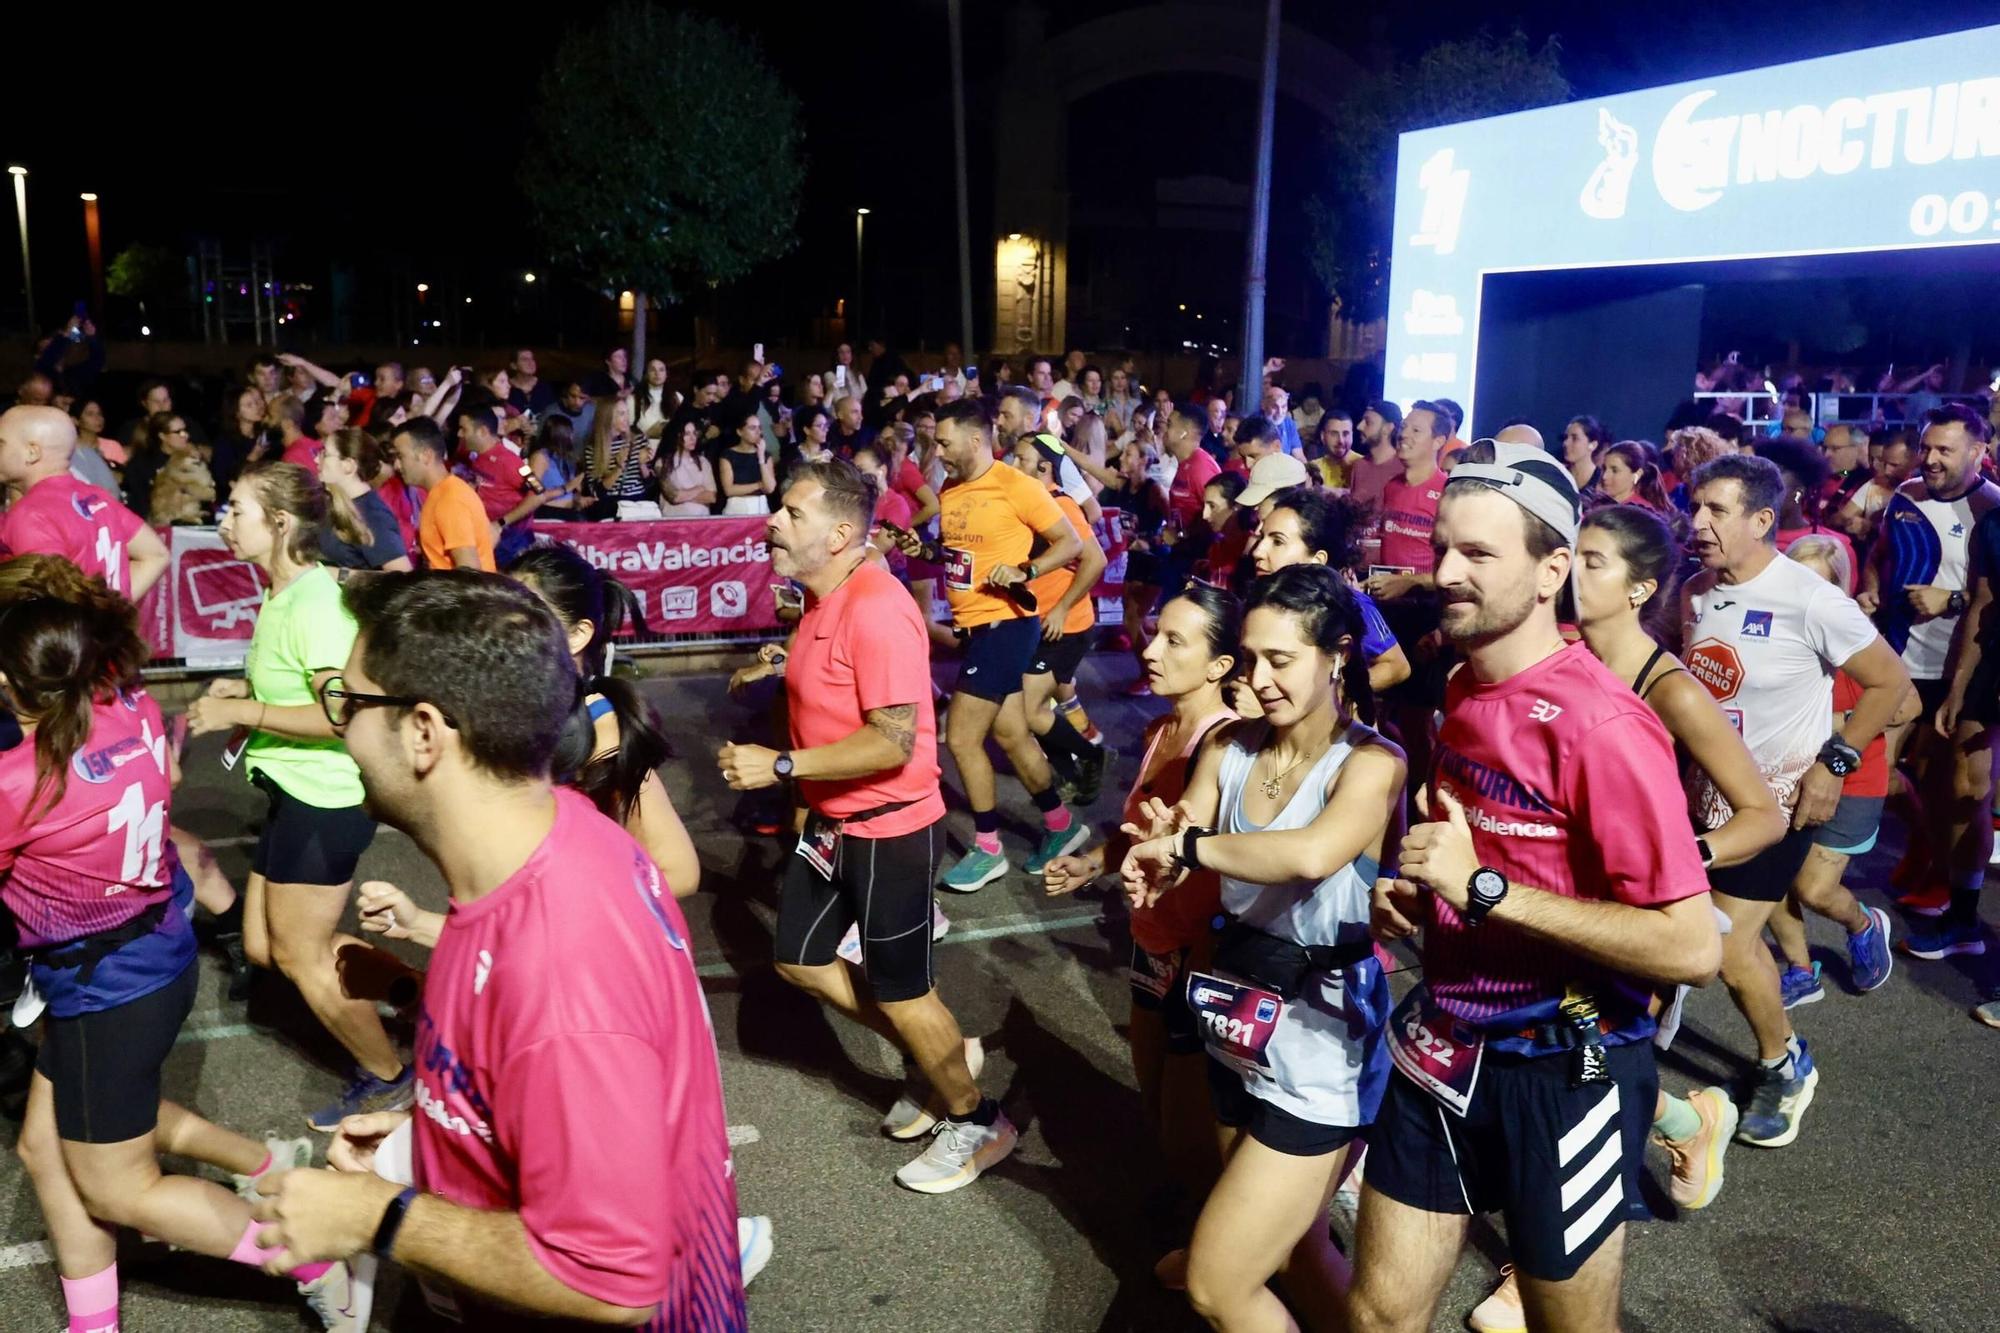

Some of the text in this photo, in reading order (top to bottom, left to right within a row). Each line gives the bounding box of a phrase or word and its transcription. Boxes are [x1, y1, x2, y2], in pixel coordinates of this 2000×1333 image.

[1741, 622, 1765, 635] AXA
[1689, 664, 1730, 692] FRENO
[1692, 652, 1735, 680] PONLE
[1201, 1010, 1255, 1047] 7821
